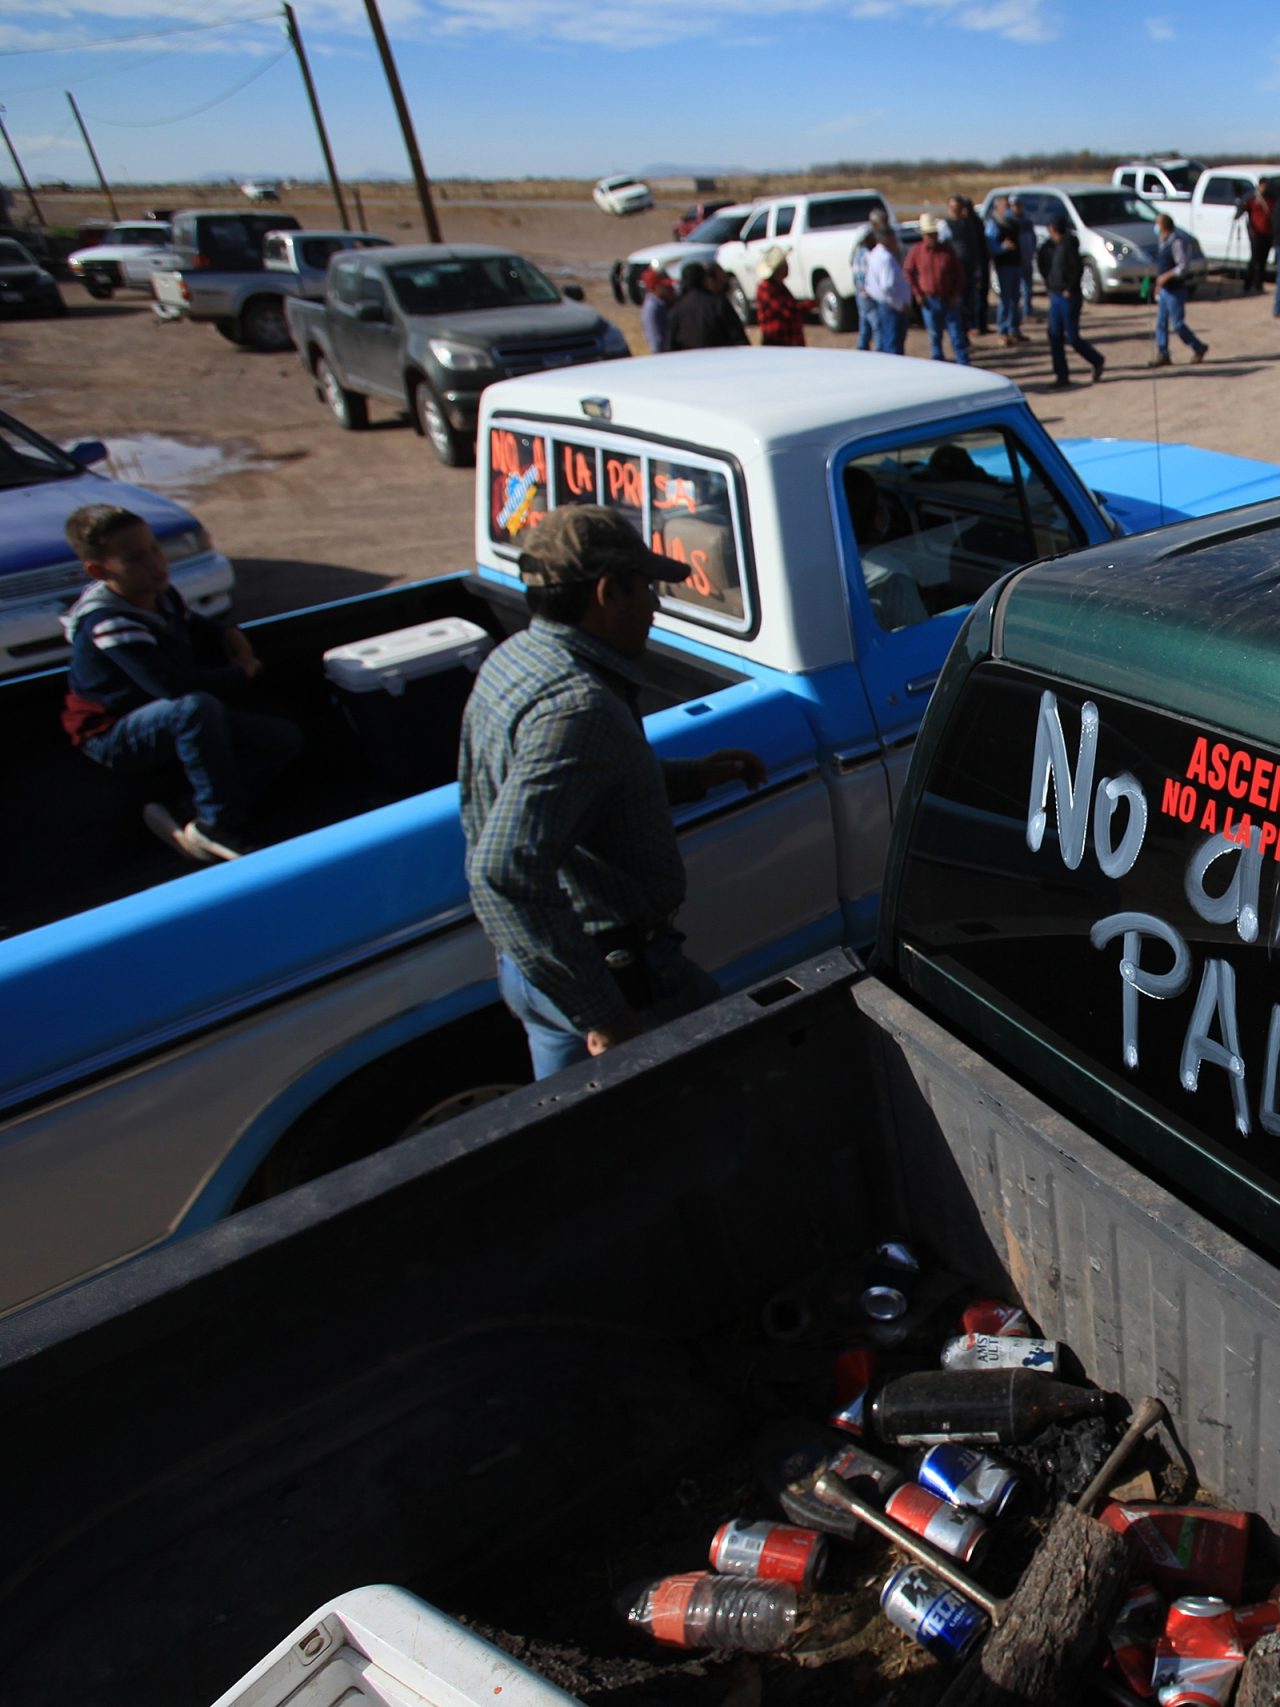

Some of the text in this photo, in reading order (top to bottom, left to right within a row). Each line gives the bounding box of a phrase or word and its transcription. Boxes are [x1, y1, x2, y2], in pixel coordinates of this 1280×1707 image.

[490, 428, 521, 476] NO
[564, 445, 593, 496] LA
[607, 458, 697, 514] PRSA
[1027, 690, 1147, 880] No
[1161, 778, 1196, 824] NO
[1200, 799, 1217, 835] A
[1223, 805, 1252, 848] LA
